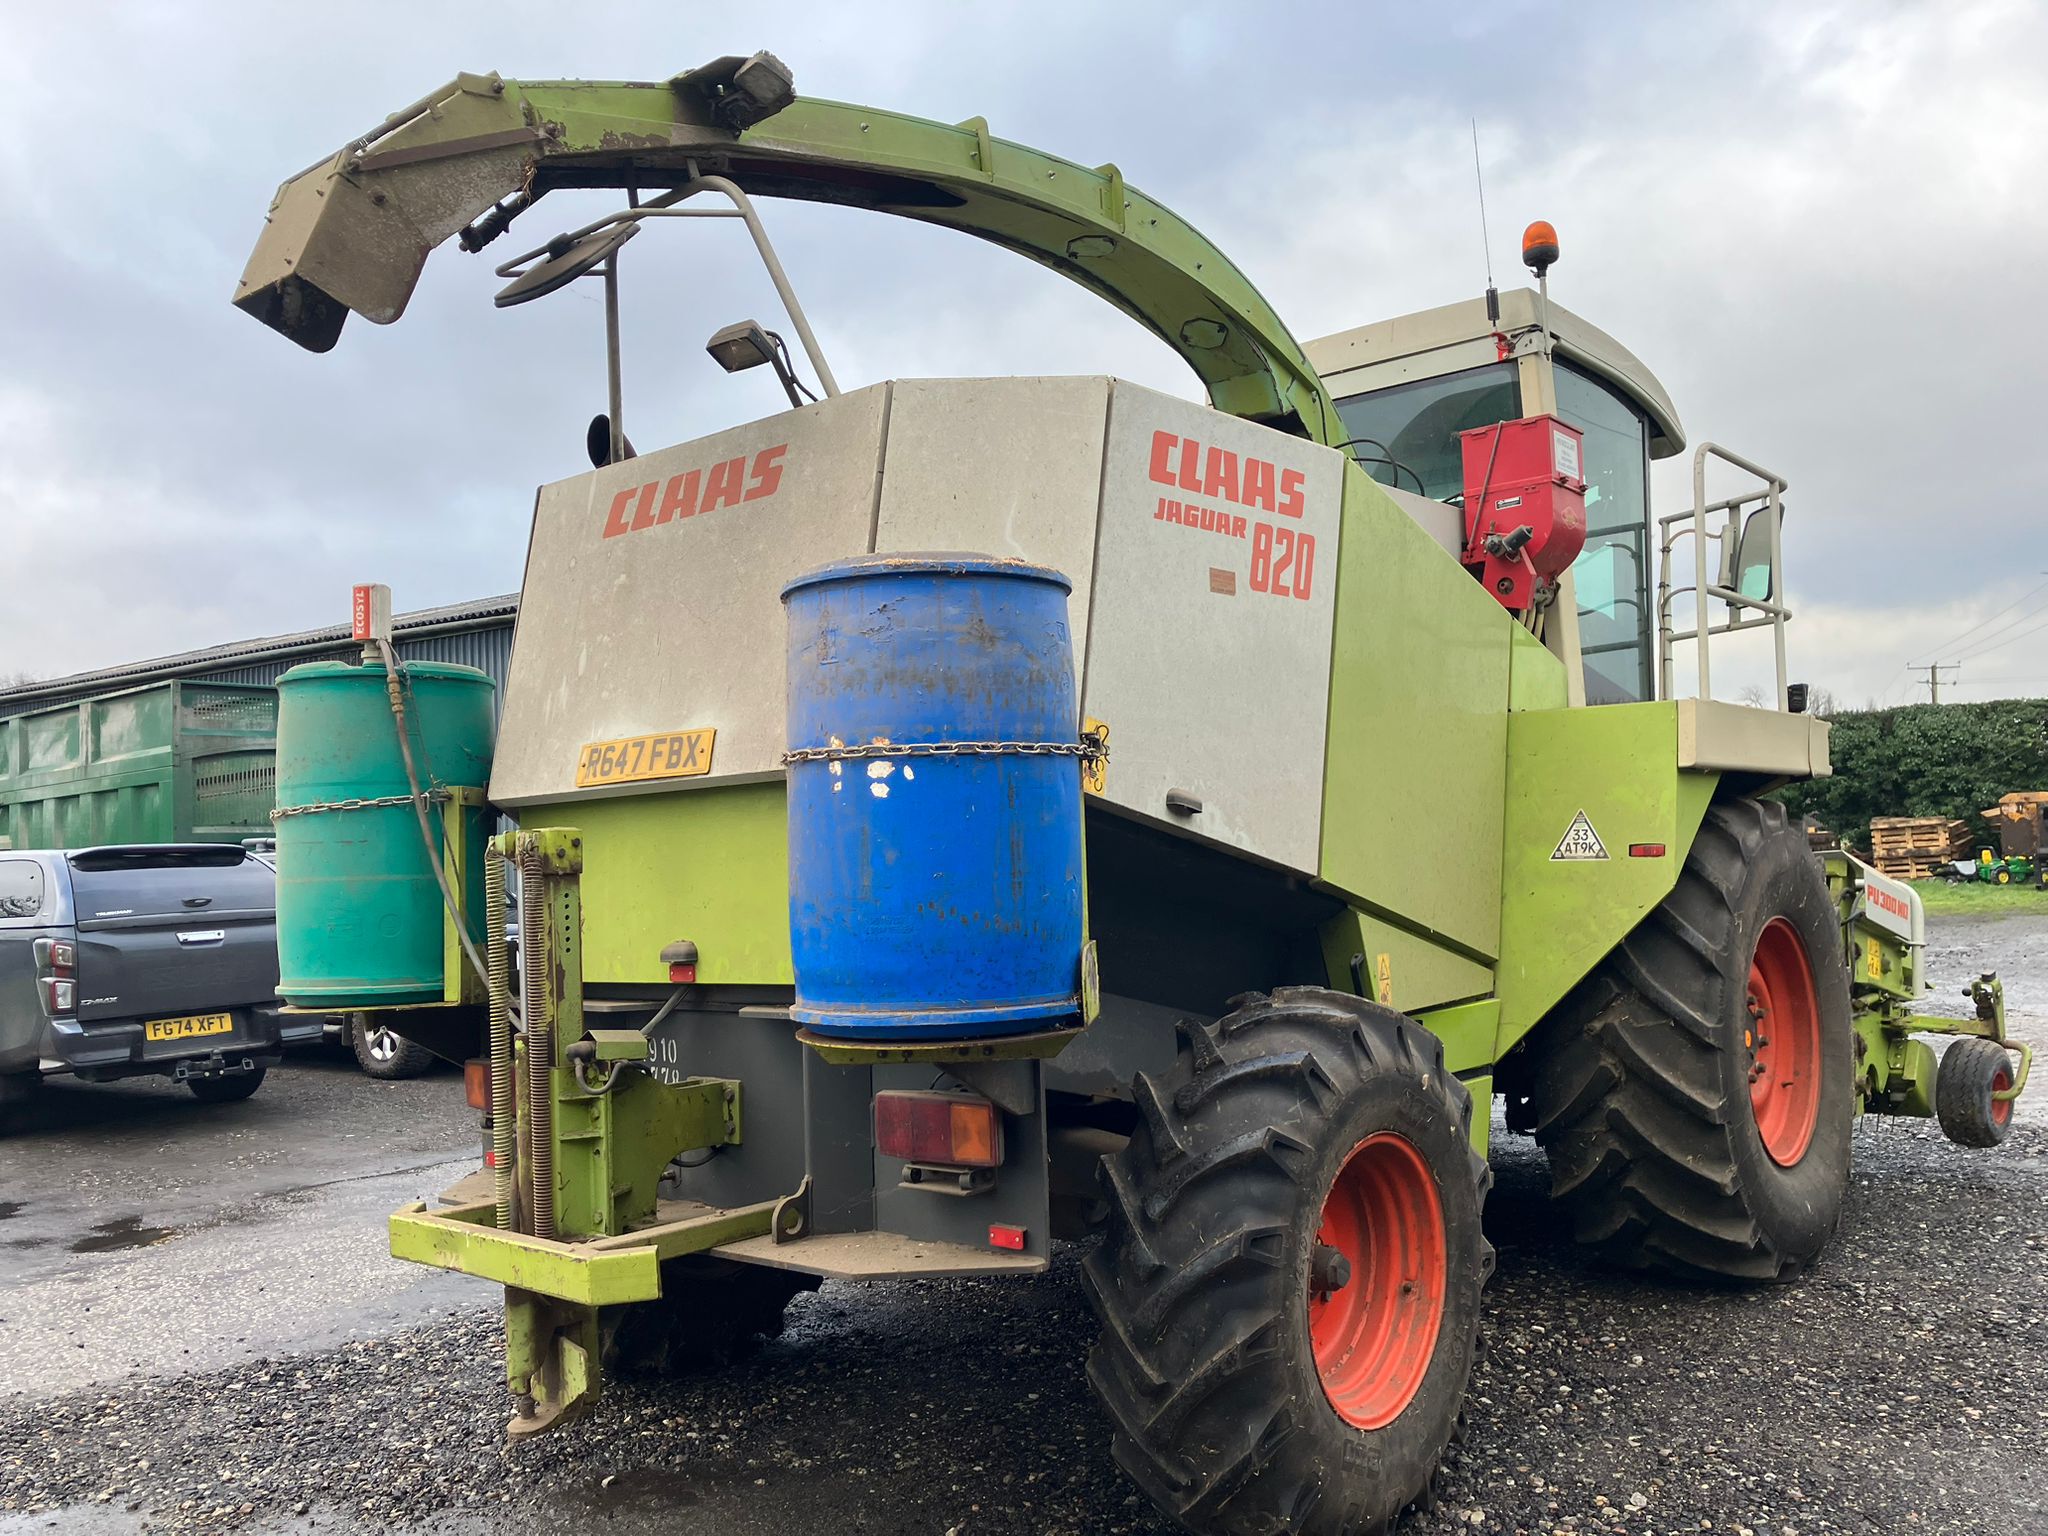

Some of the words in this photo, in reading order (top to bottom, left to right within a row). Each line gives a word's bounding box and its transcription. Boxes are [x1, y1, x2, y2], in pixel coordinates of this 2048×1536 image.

[602, 443, 789, 539] CLAAS
[1149, 430, 1305, 519] CLAAS
[1153, 497, 1247, 539] JAGUAR
[1250, 521, 1315, 601] 820
[356, 590, 365, 634] ECOSYL
[584, 740, 646, 779] R647
[648, 734, 702, 771] FBX
[1564, 842, 1596, 854] AT9K
[1572, 829, 1589, 841] 33
[1867, 884, 1879, 908] PU
[1879, 891, 1897, 915] 300
[152, 1020, 193, 1038] FG74
[198, 1015, 225, 1032] XFT
[643, 1037, 677, 1063] 910
[641, 1066, 679, 1085] 778
